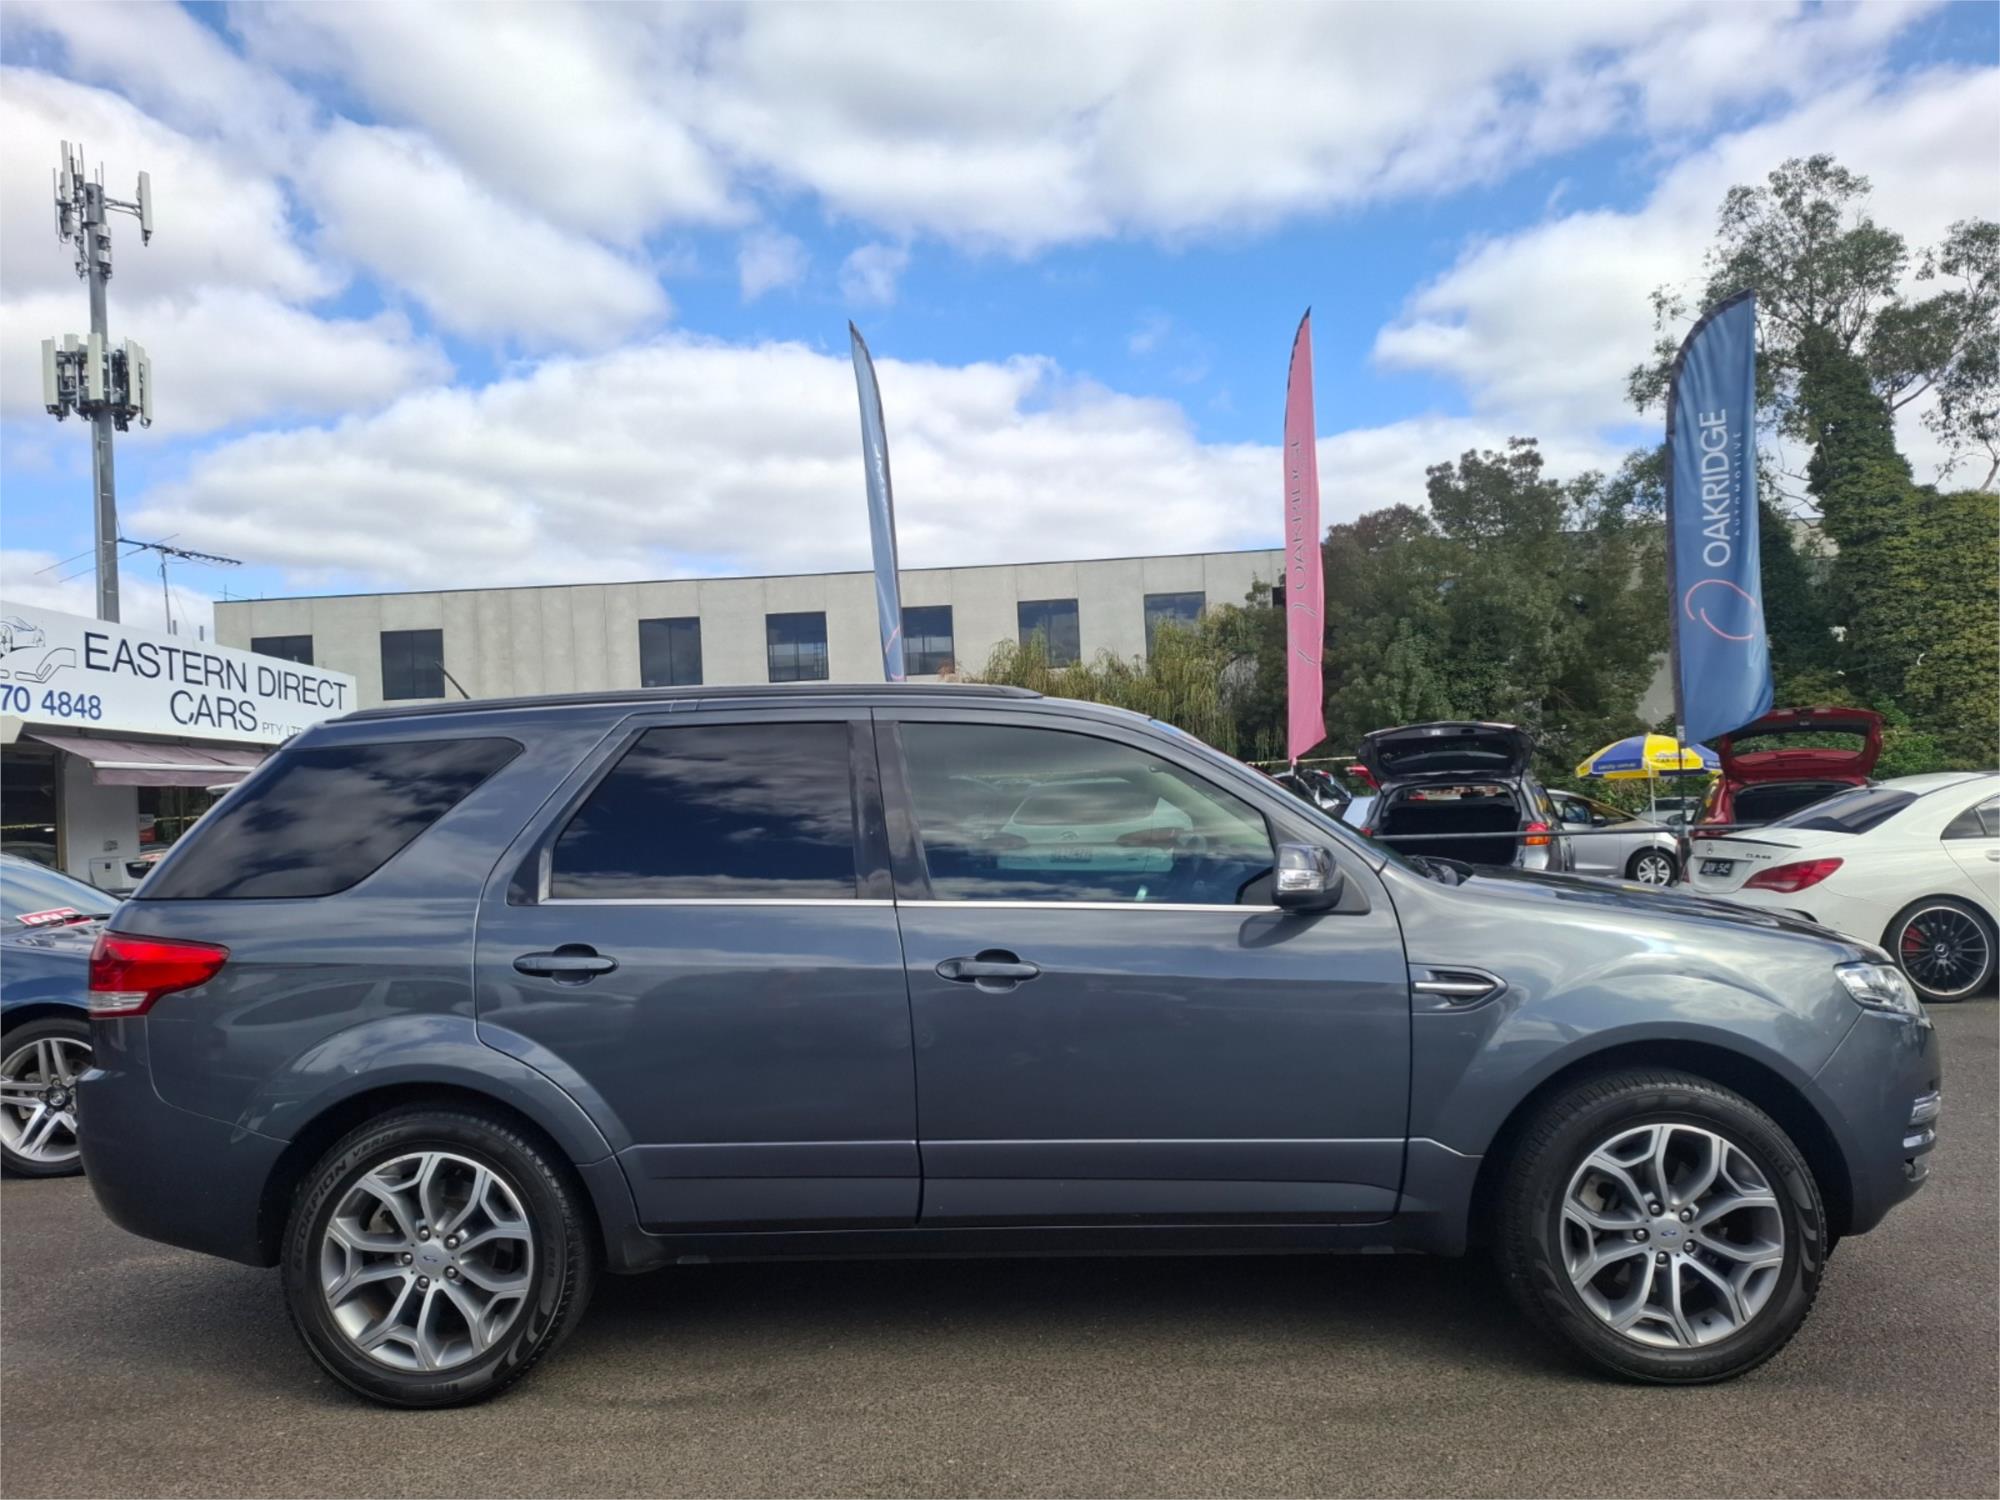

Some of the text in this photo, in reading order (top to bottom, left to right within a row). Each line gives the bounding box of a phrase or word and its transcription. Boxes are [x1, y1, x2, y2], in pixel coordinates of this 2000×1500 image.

[1291, 441, 1307, 591] OAKRI
[1698, 408, 1732, 568] OAKRIDGE
[1732, 431, 1743, 537] AUTOMOTIVE
[41, 689, 103, 720] 4848
[84, 631, 347, 711] EASTERN DIRECT
[169, 689, 258, 732] CARS
[262, 721, 283, 735] PTY
[292, 1158, 348, 1271] SCORPION
